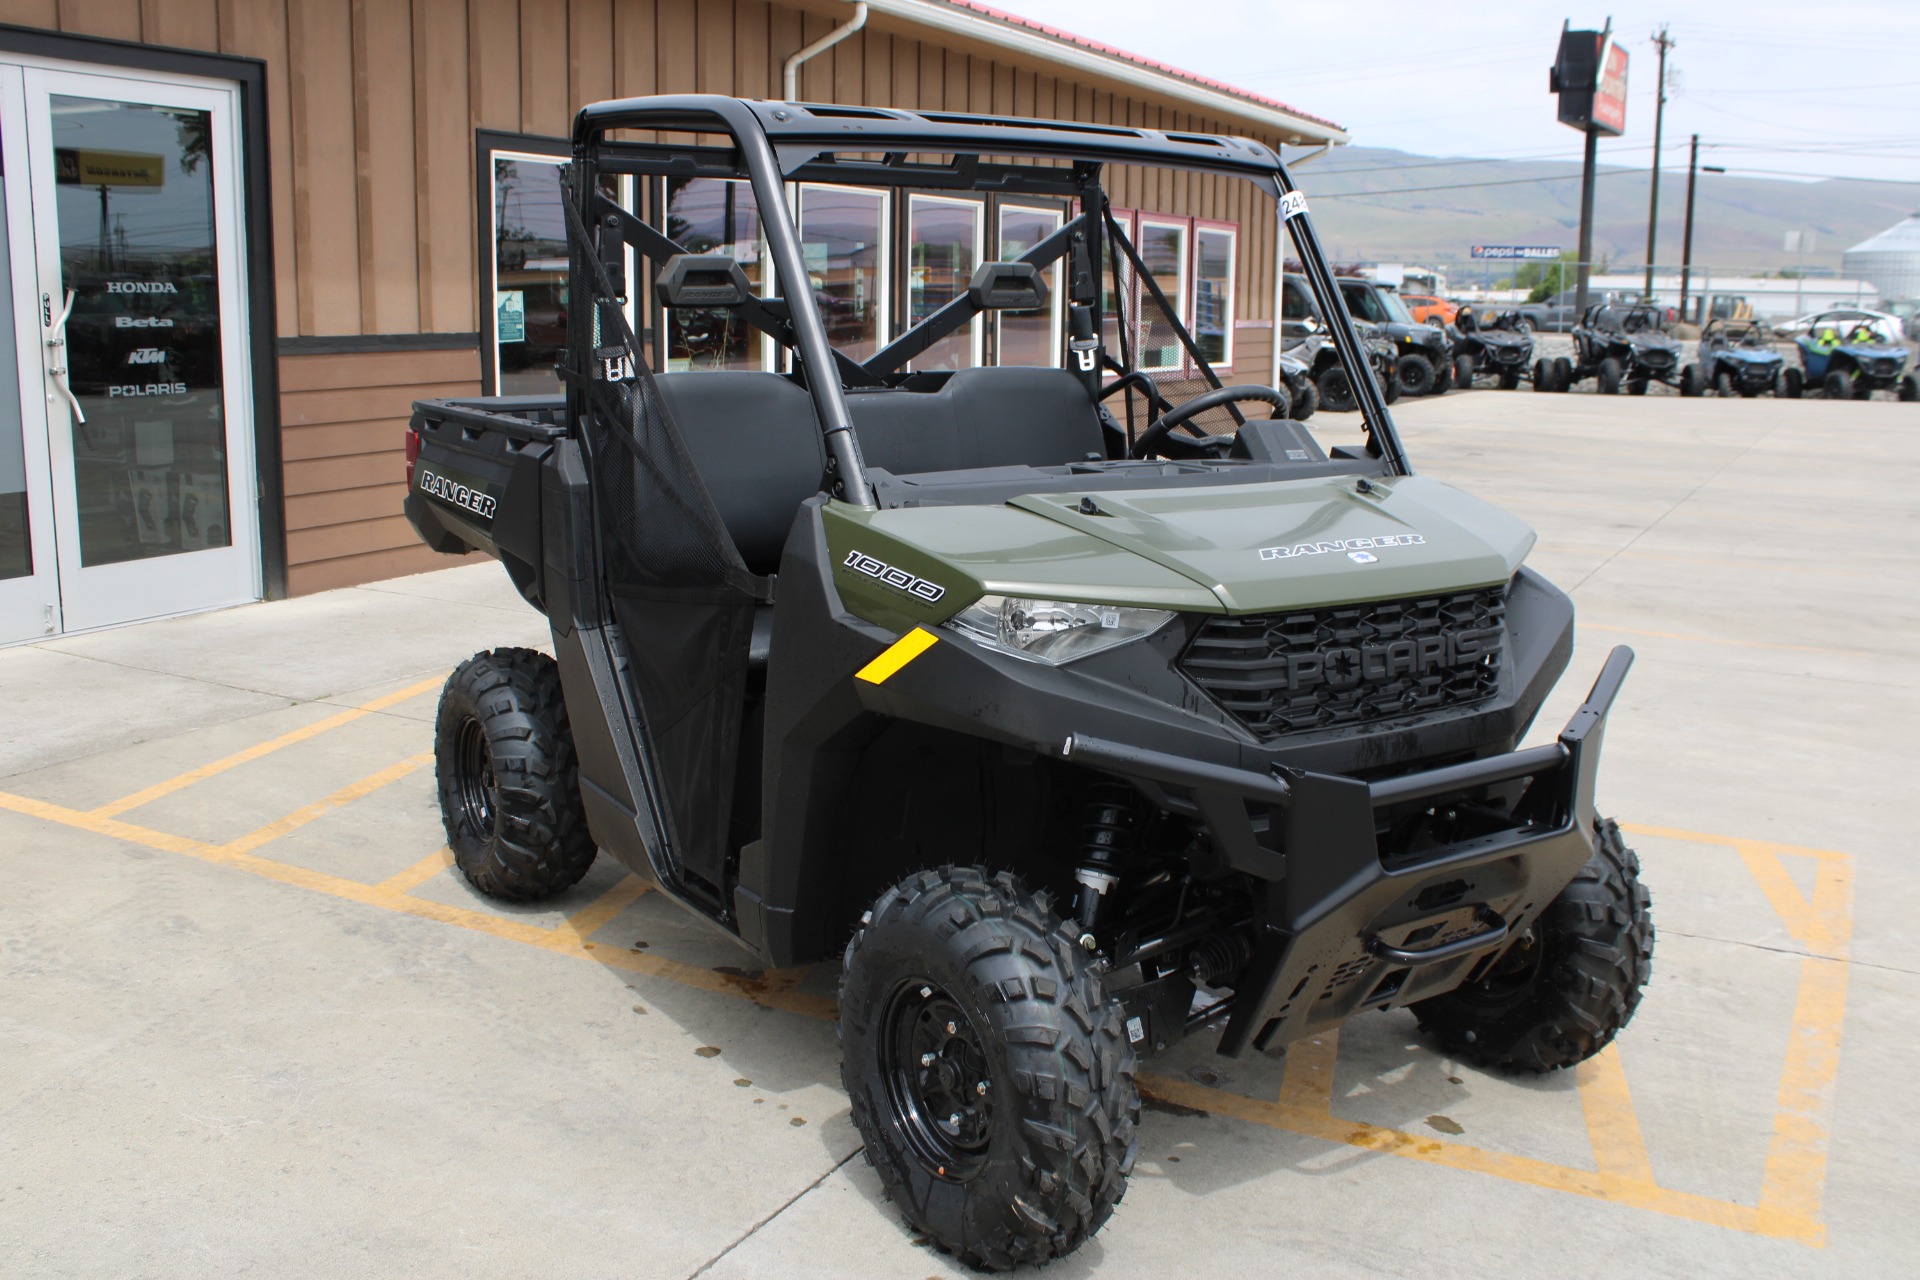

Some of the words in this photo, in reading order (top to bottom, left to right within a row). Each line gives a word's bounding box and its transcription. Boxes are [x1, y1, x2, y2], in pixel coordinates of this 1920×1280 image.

[106, 282, 178, 294] HONDA
[115, 316, 174, 328] Beta
[127, 348, 166, 365] KTM
[109, 382, 187, 398] POLARIS
[420, 469, 497, 519] RANGER
[1259, 533, 1426, 561] RANGER
[843, 549, 946, 604] 1000
[1287, 629, 1482, 690] POLARIS
